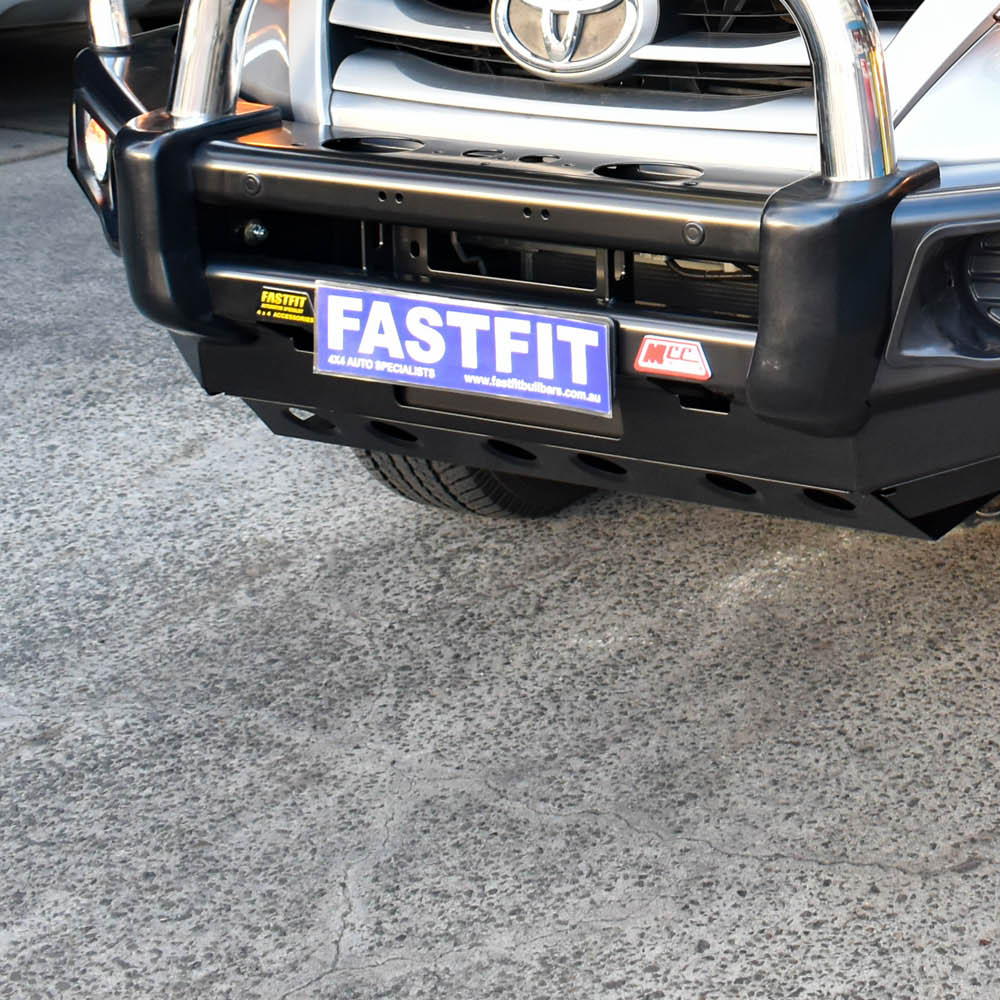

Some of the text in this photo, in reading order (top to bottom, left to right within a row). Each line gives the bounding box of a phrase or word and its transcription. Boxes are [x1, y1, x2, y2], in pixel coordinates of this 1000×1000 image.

[261, 290, 307, 308] FASTFIT
[327, 294, 599, 385] FASTFIT
[347, 356, 373, 371] AUTO
[375, 359, 436, 379] SPECIALISTS
